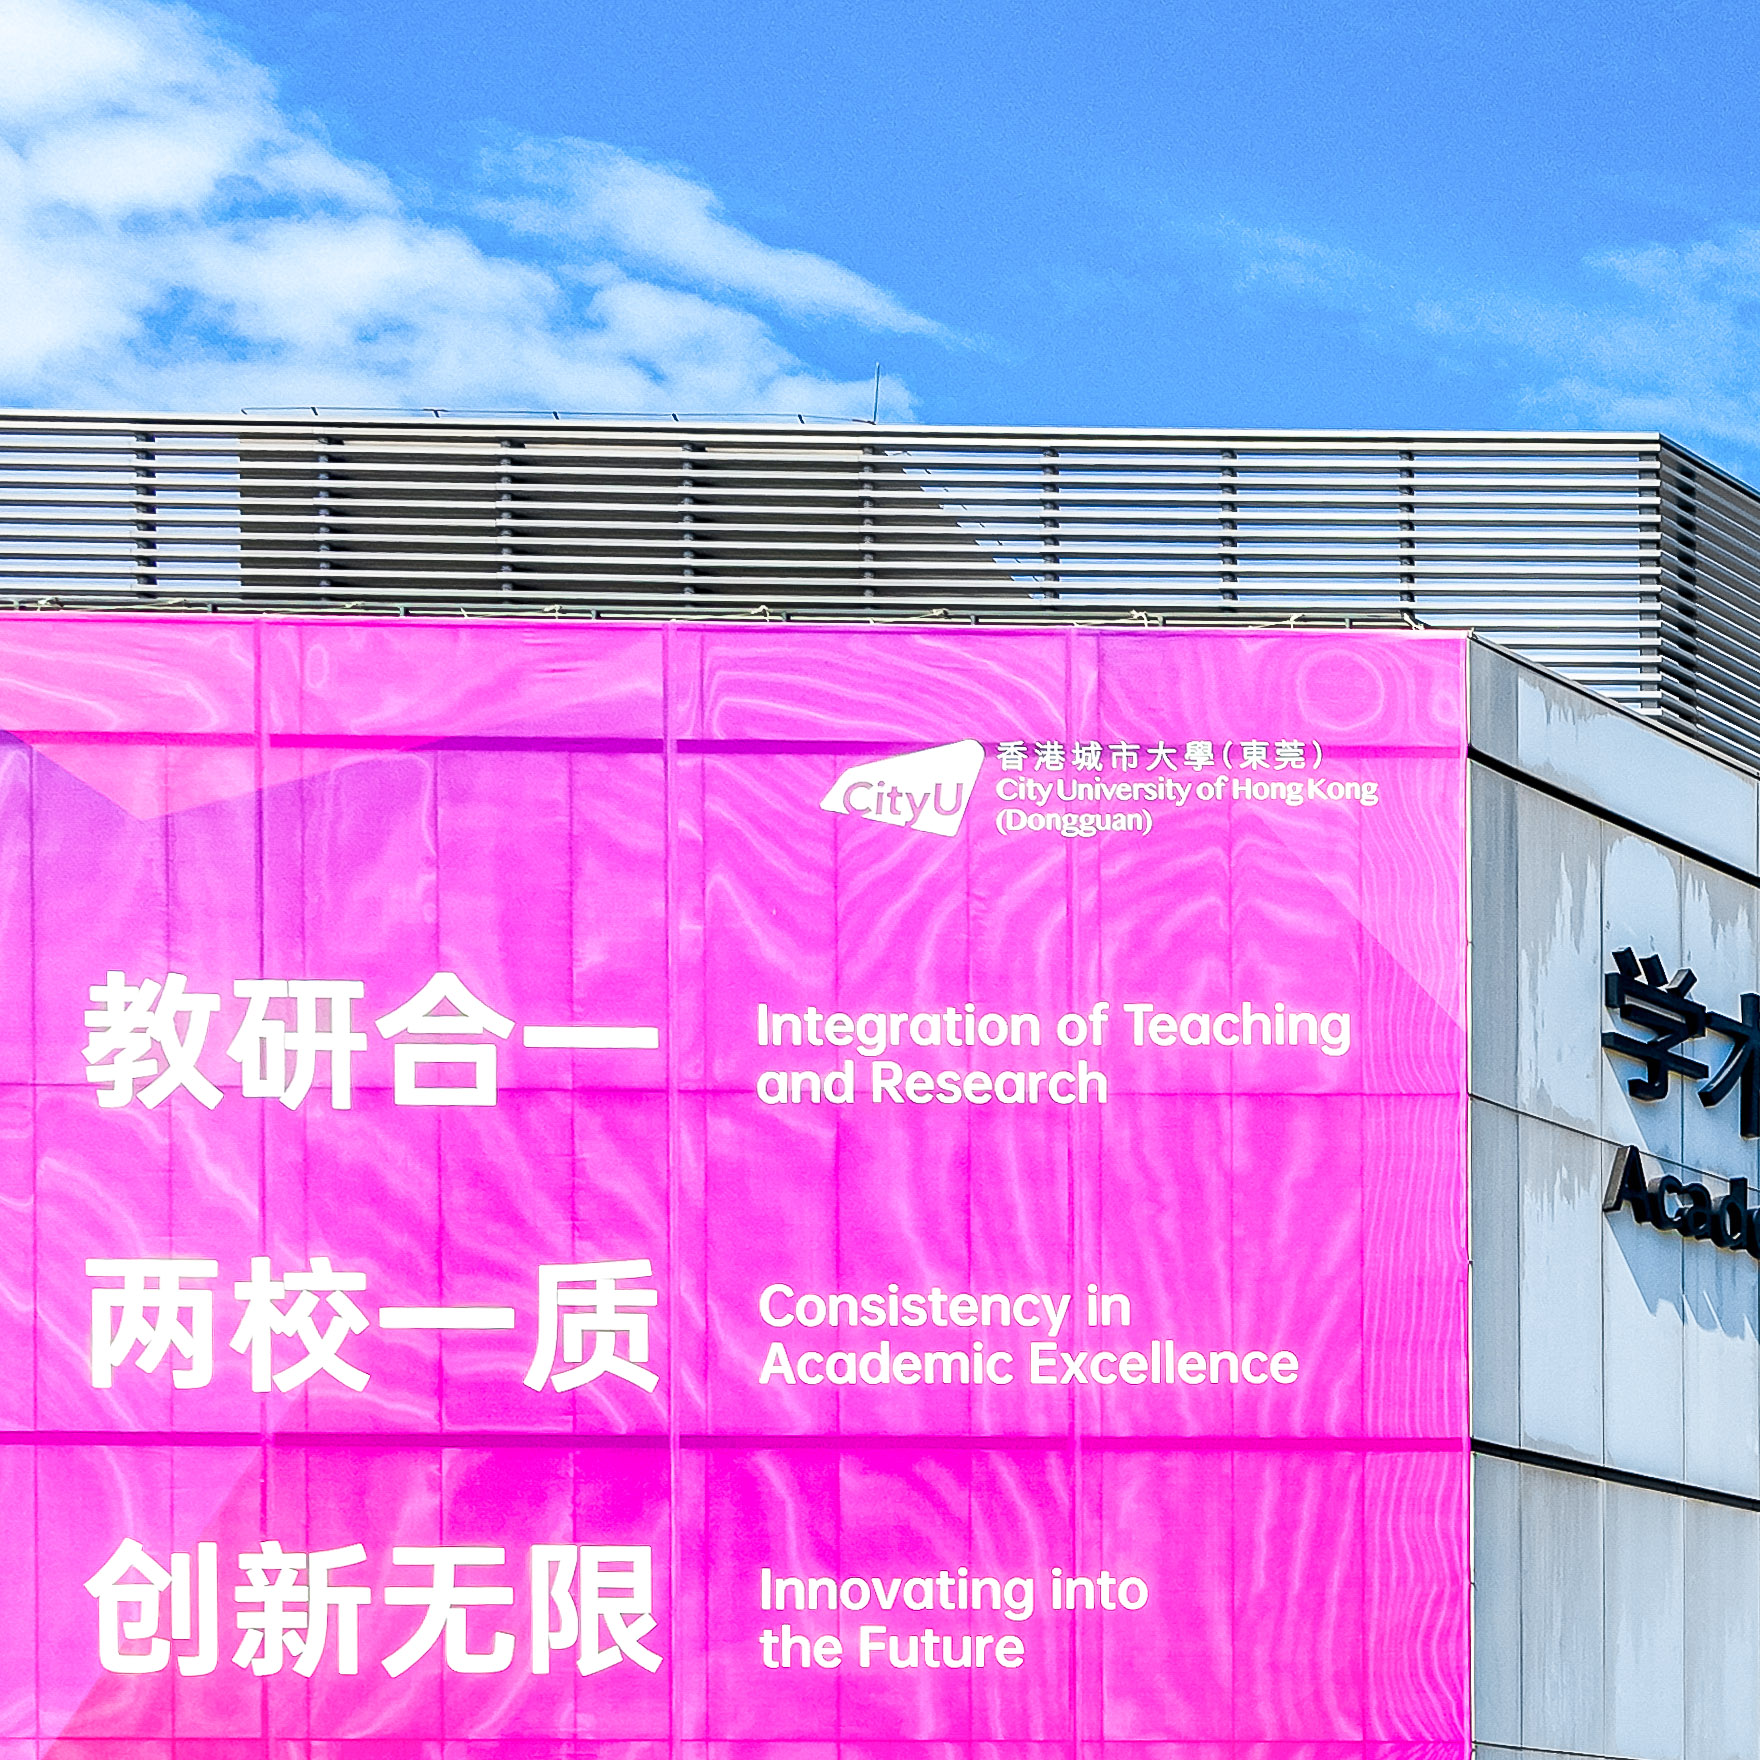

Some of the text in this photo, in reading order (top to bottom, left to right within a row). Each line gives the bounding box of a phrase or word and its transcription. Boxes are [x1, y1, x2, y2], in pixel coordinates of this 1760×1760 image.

[996, 739, 1322, 772] 香港城市大學(東莞)
[843, 781, 963, 827] CityU
[995, 774, 1379, 807] City University of Hong Kong
[995, 808, 1153, 838] (Dongguan)
[82, 970, 659, 1111] 教研合一
[758, 1001, 1351, 1057] Integration of Teaching
[756, 1059, 1107, 1105] and Research
[84, 1256, 660, 1393] 两校一质
[759, 1283, 1130, 1337] Consistency in
[758, 1339, 1299, 1385] Academic Excellence
[83, 1537, 663, 1678] 创新无限
[761, 1567, 1149, 1621] Innovating into
[759, 1624, 1028, 1669] the Future
